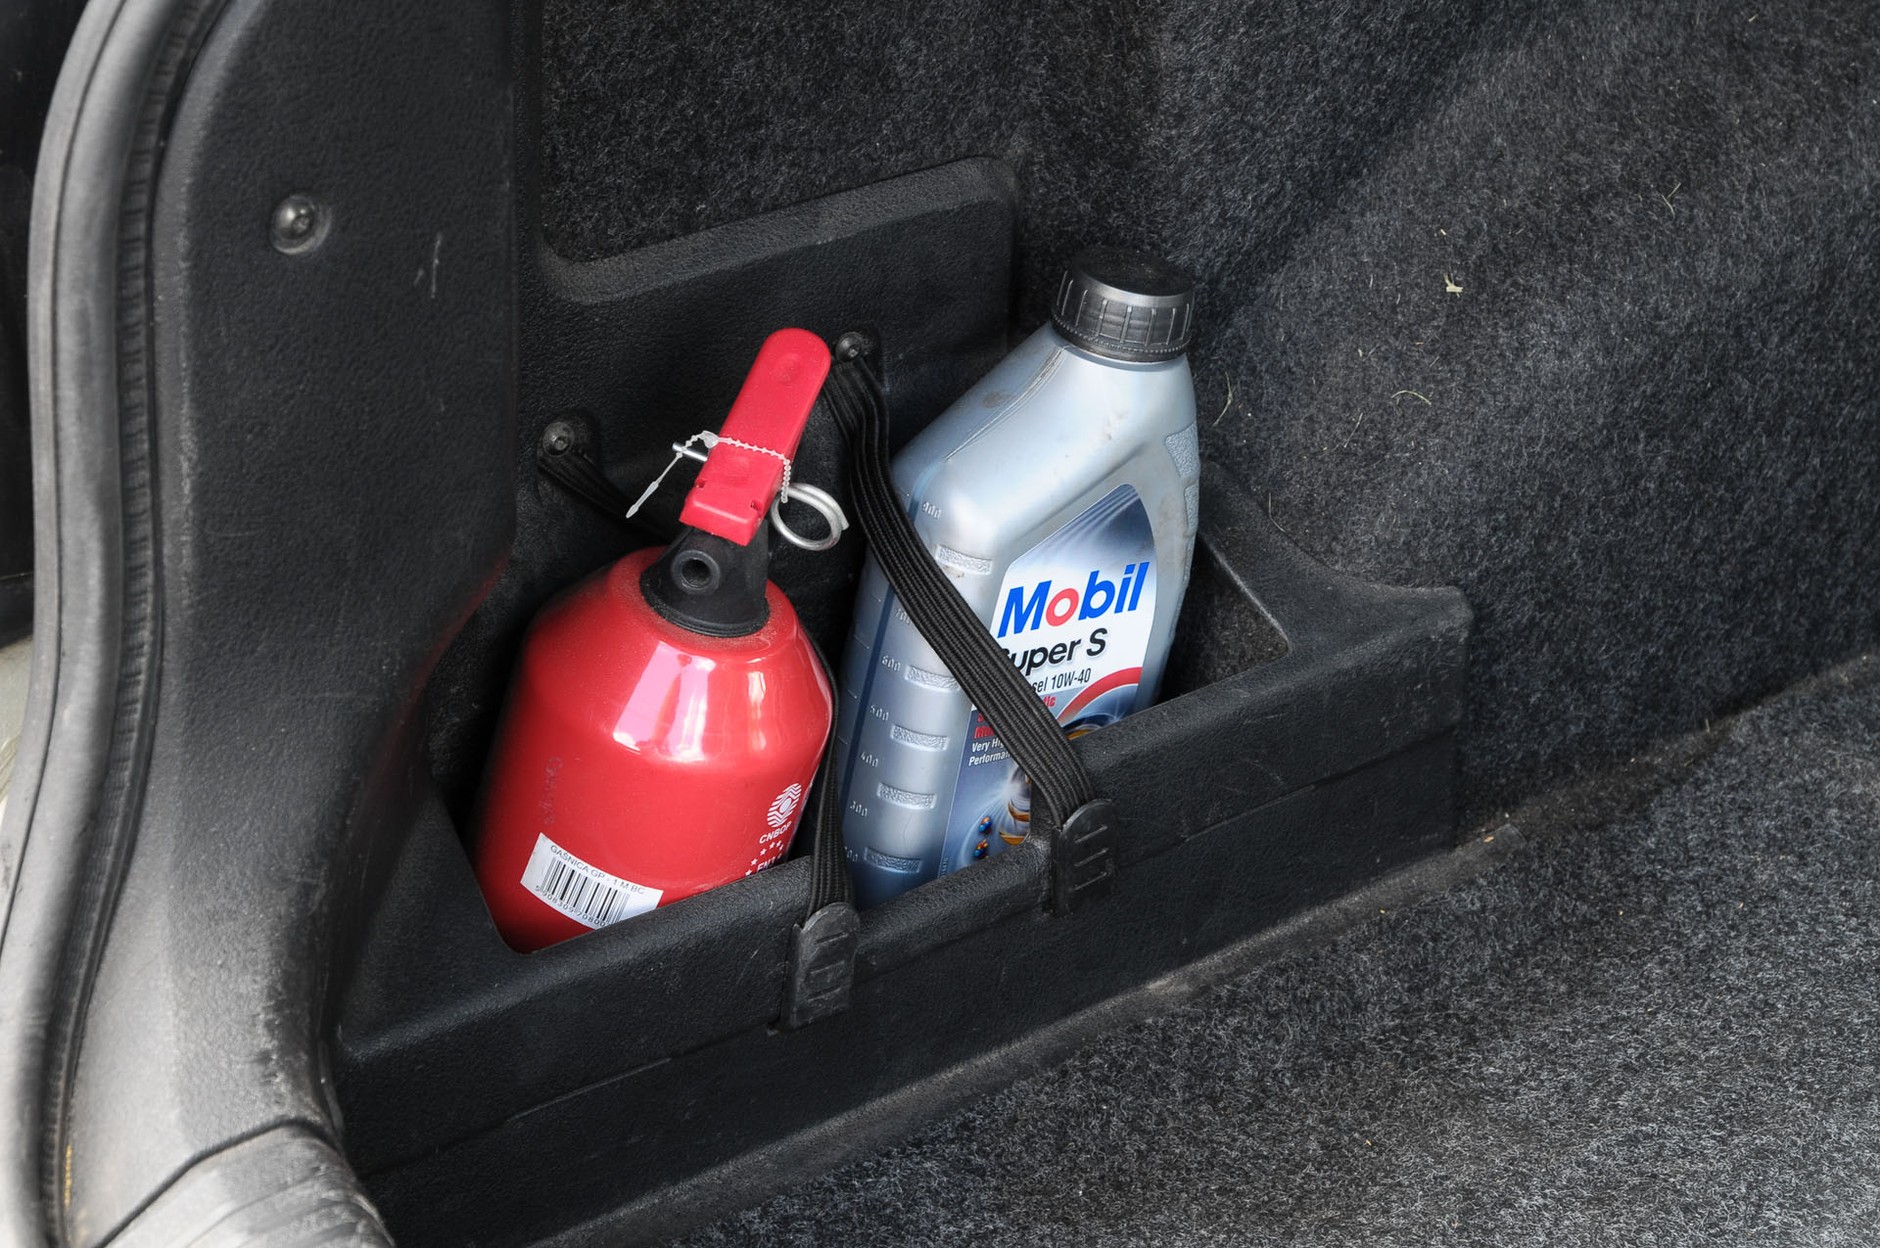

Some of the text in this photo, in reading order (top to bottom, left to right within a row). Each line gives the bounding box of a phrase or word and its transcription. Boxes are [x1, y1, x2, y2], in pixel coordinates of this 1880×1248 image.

[997, 561, 1150, 639] Mobil
[1086, 627, 1108, 657] S
[1051, 667, 1092, 690] 10W-40
[972, 741, 990, 753] Very
[860, 751, 879, 768] 400
[968, 751, 1011, 767] Performan
[759, 820, 792, 844] CNBOP
[590, 868, 605, 880] GP
[630, 885, 646, 895] BC
